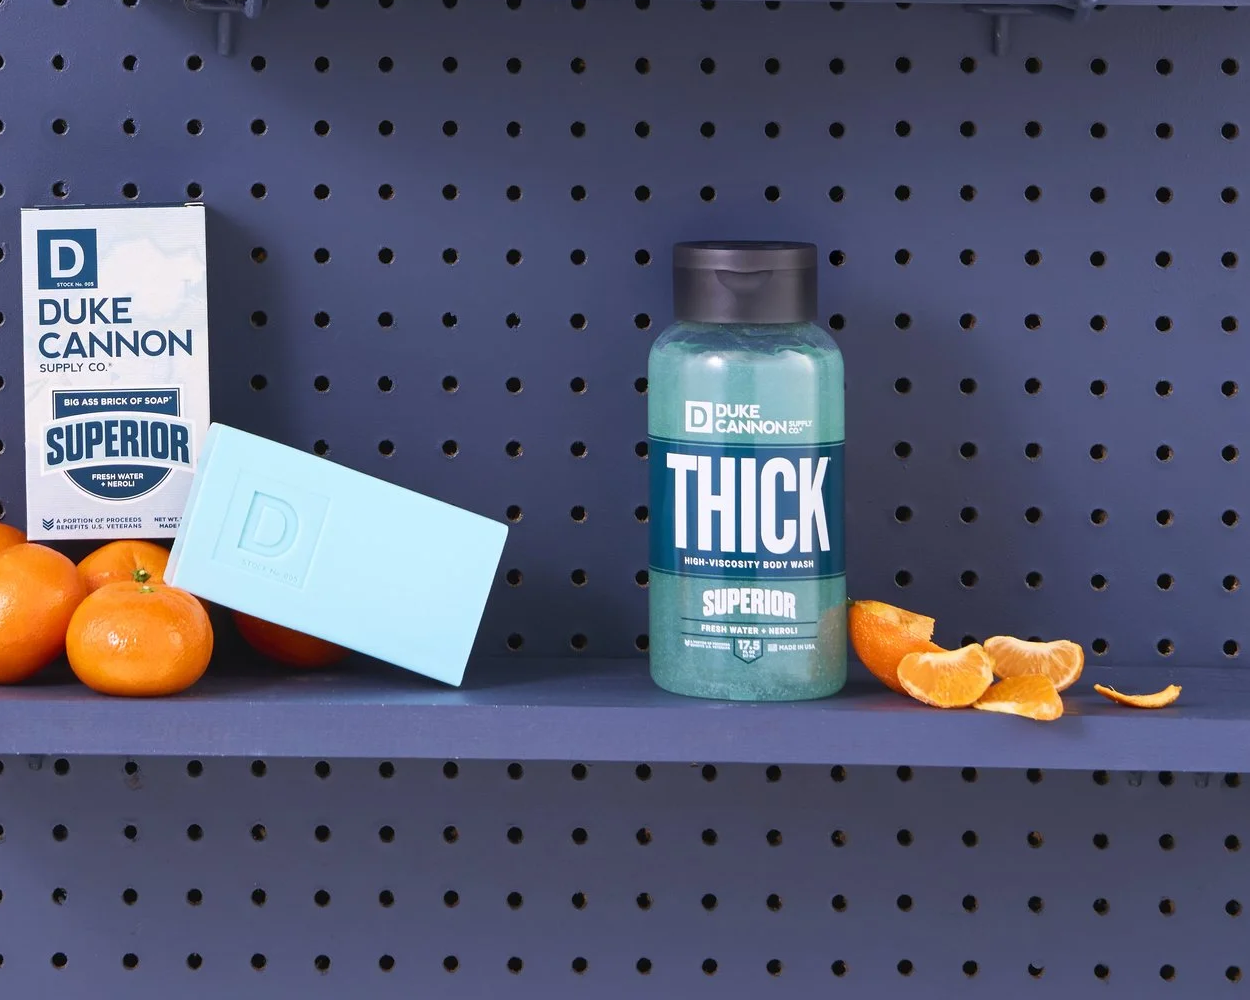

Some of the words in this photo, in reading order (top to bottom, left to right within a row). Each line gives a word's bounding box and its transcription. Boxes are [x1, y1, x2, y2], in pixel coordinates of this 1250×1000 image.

[50, 239, 85, 279] D
[38, 297, 132, 325] DUKE
[38, 329, 192, 358] CANNON
[39, 363, 84, 372] SUPPLY
[64, 398, 80, 406] BIG
[81, 398, 99, 406] ASS
[101, 397, 128, 405] BRICK
[130, 397, 142, 405] OF
[715, 403, 760, 418] DUKE
[715, 420, 787, 434] CANNON
[46, 420, 190, 465] SUPERIOR
[666, 452, 830, 554] THICK
[238, 490, 299, 557] D
[684, 556, 760, 569] HIGH-VISCOSITY
[763, 561, 788, 569] BODY
[790, 560, 814, 568] WASH
[702, 588, 796, 619] SUPERIOR
[701, 624, 727, 633] FRESH
[729, 626, 758, 634] WATER
[768, 627, 798, 635] NEROLI
[738, 640, 760, 650] 17.5
